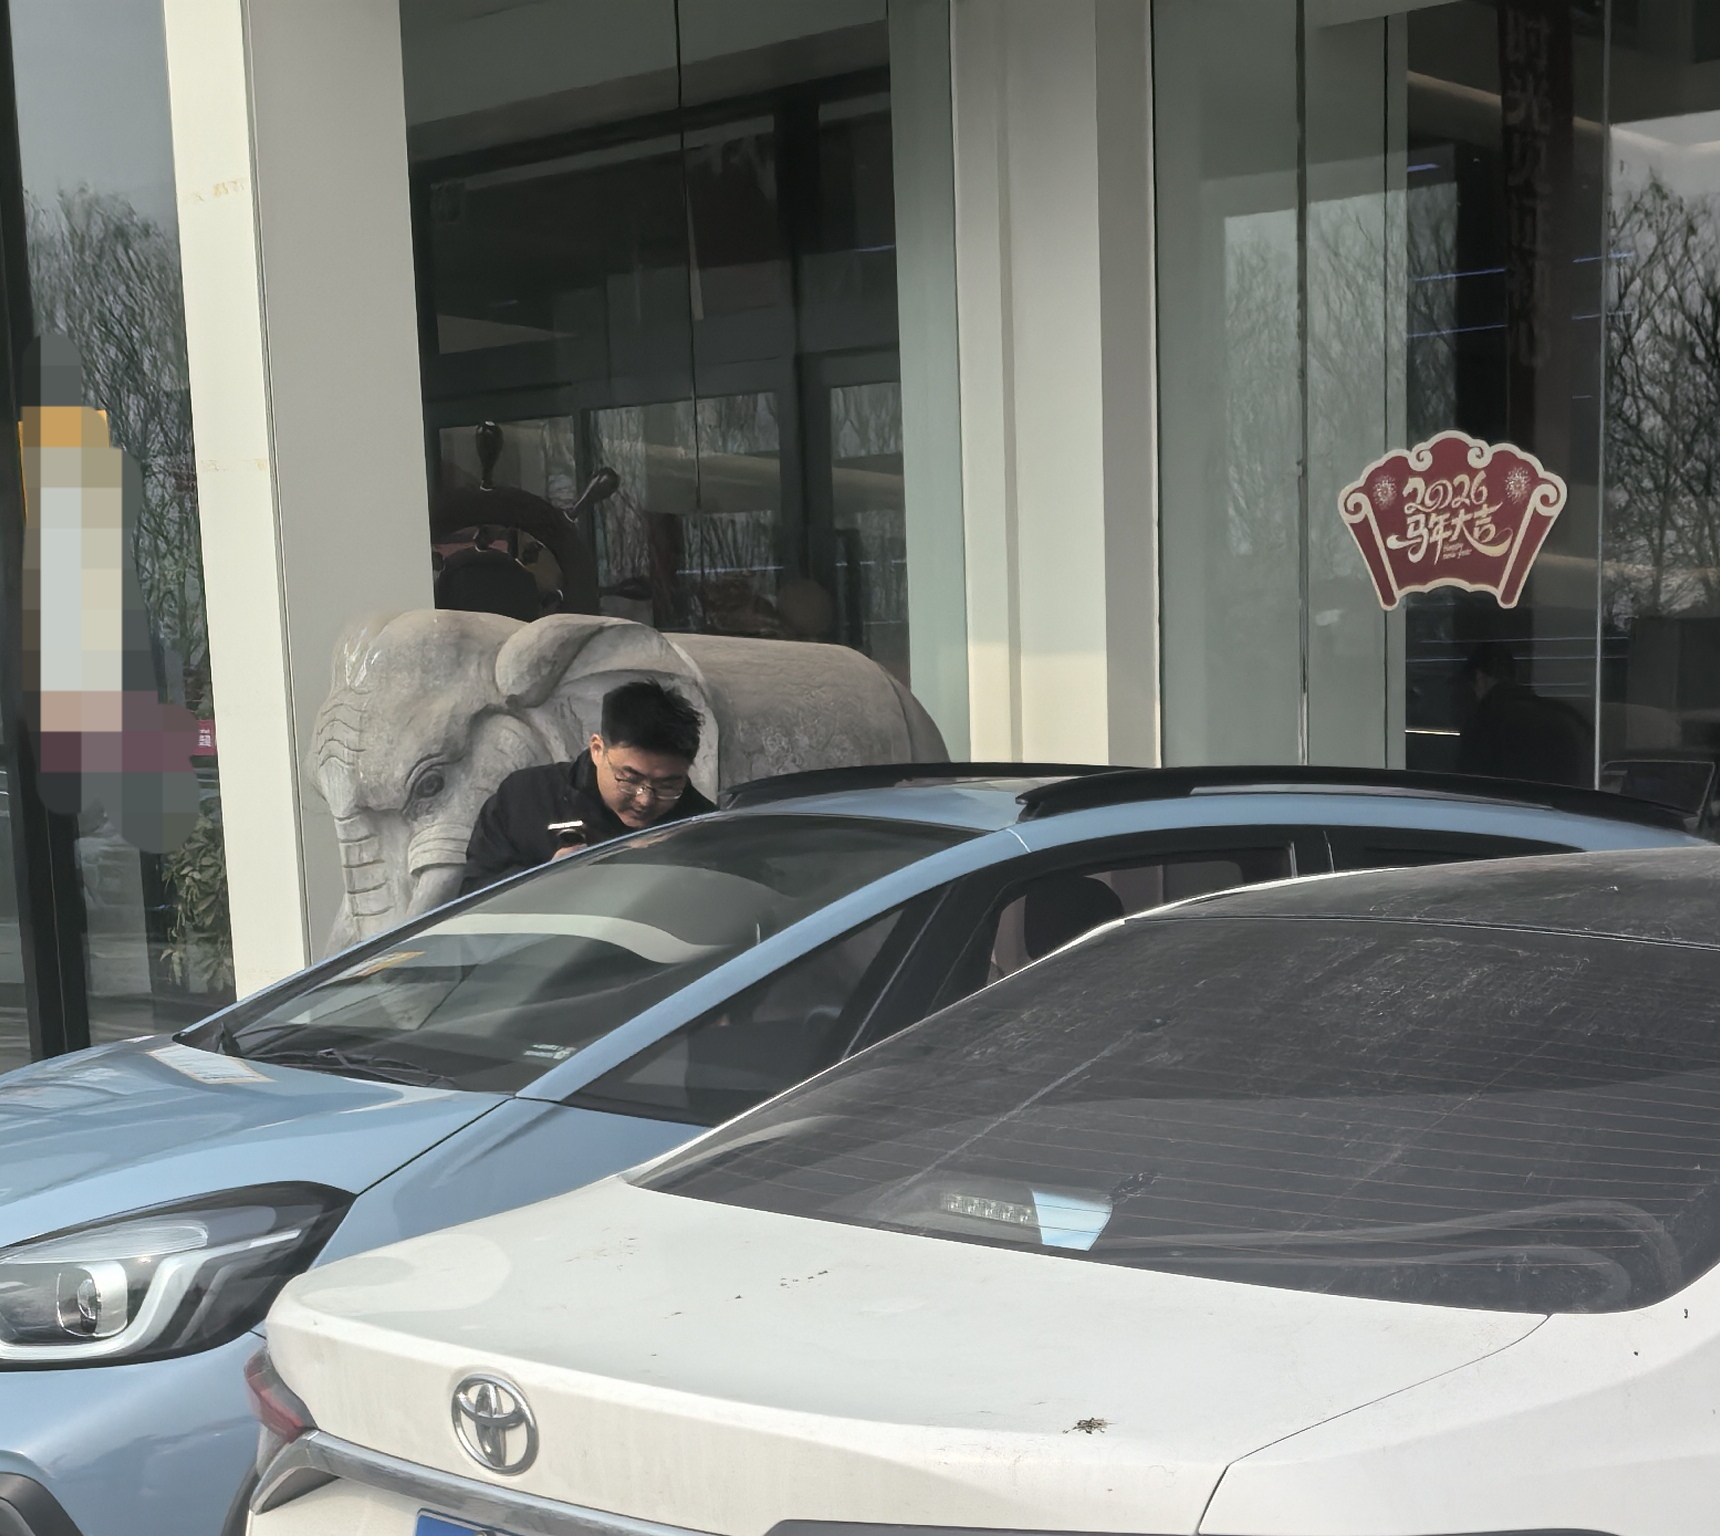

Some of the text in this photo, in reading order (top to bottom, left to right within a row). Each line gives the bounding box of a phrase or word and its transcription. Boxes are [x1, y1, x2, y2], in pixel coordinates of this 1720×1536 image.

[1402, 470, 1488, 514] 2026
[1386, 501, 1513, 565] 马年大吉
